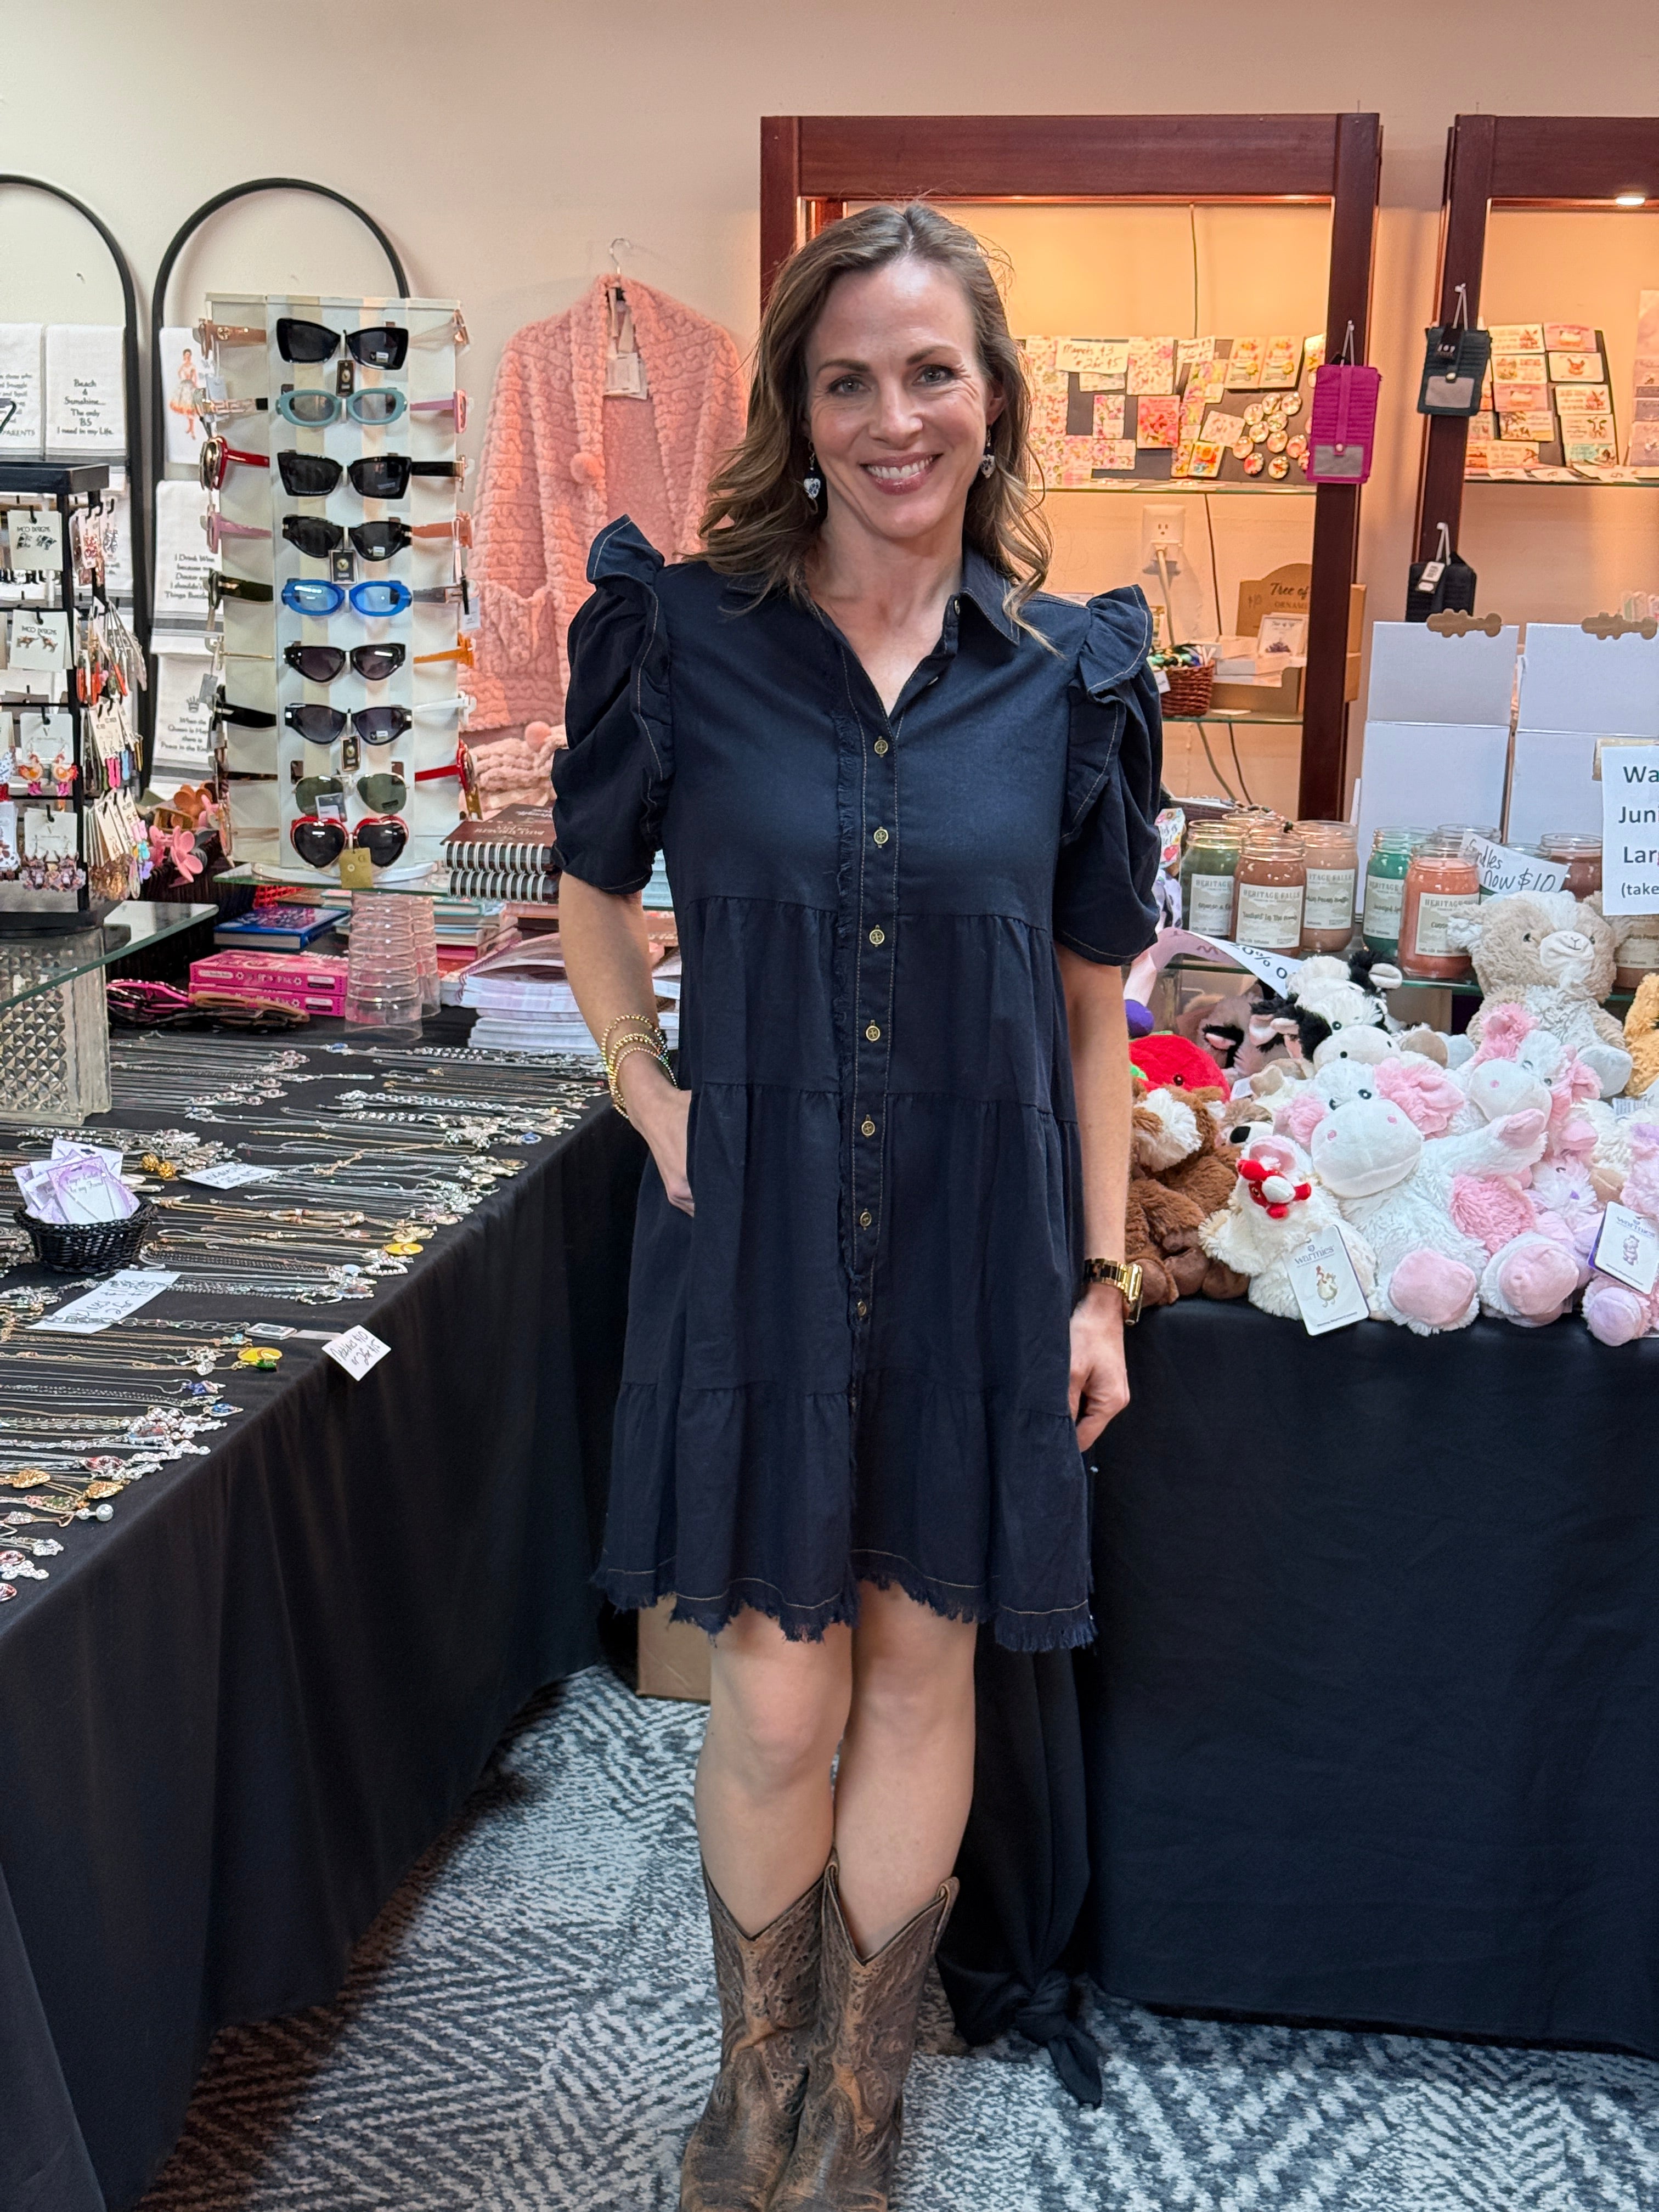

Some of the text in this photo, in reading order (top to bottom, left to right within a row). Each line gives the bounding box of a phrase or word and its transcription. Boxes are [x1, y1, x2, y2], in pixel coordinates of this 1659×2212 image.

[1270, 583, 1310, 600] Tree of
[1618, 806, 1659, 823] Jun
[1624, 847, 1659, 867] Lar
[1518, 867, 1556, 892] $10
[1243, 889, 1278, 899] HERITAGE
[1280, 891, 1300, 899] FALLS
[1295, 1245, 1335, 1265] warmies
[352, 1331, 369, 1343] $10
